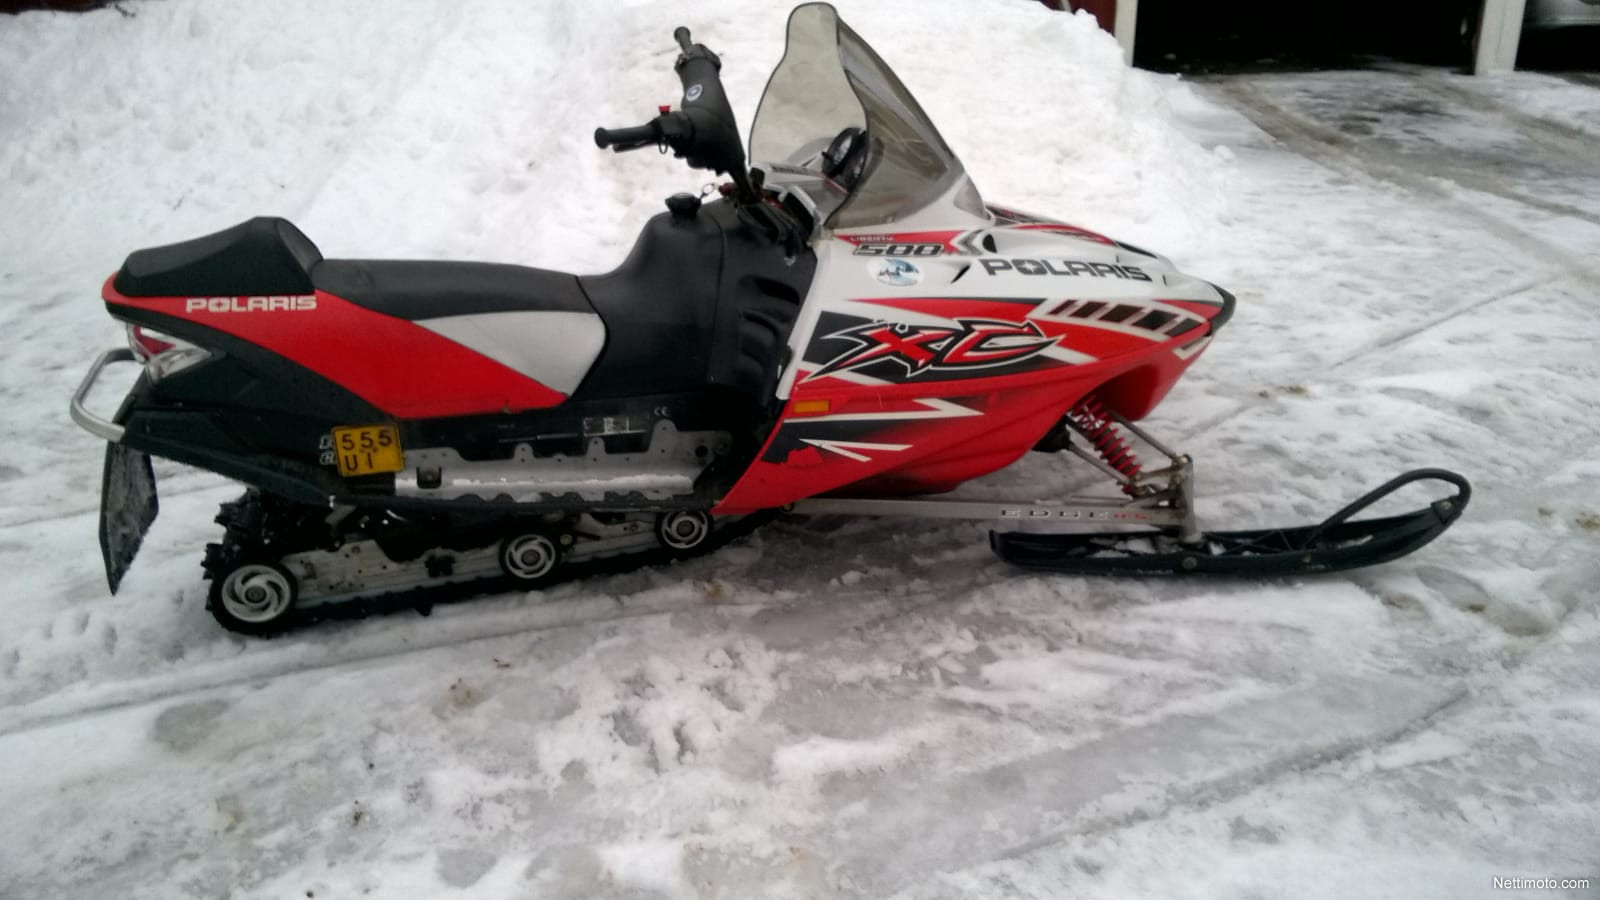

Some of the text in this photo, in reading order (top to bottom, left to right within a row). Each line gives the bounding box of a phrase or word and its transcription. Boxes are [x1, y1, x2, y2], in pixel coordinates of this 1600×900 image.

[854, 242, 944, 256] 500
[979, 258, 1153, 282] POLARIS
[185, 295, 317, 313] POLARIS
[342, 430, 392, 450] 555
